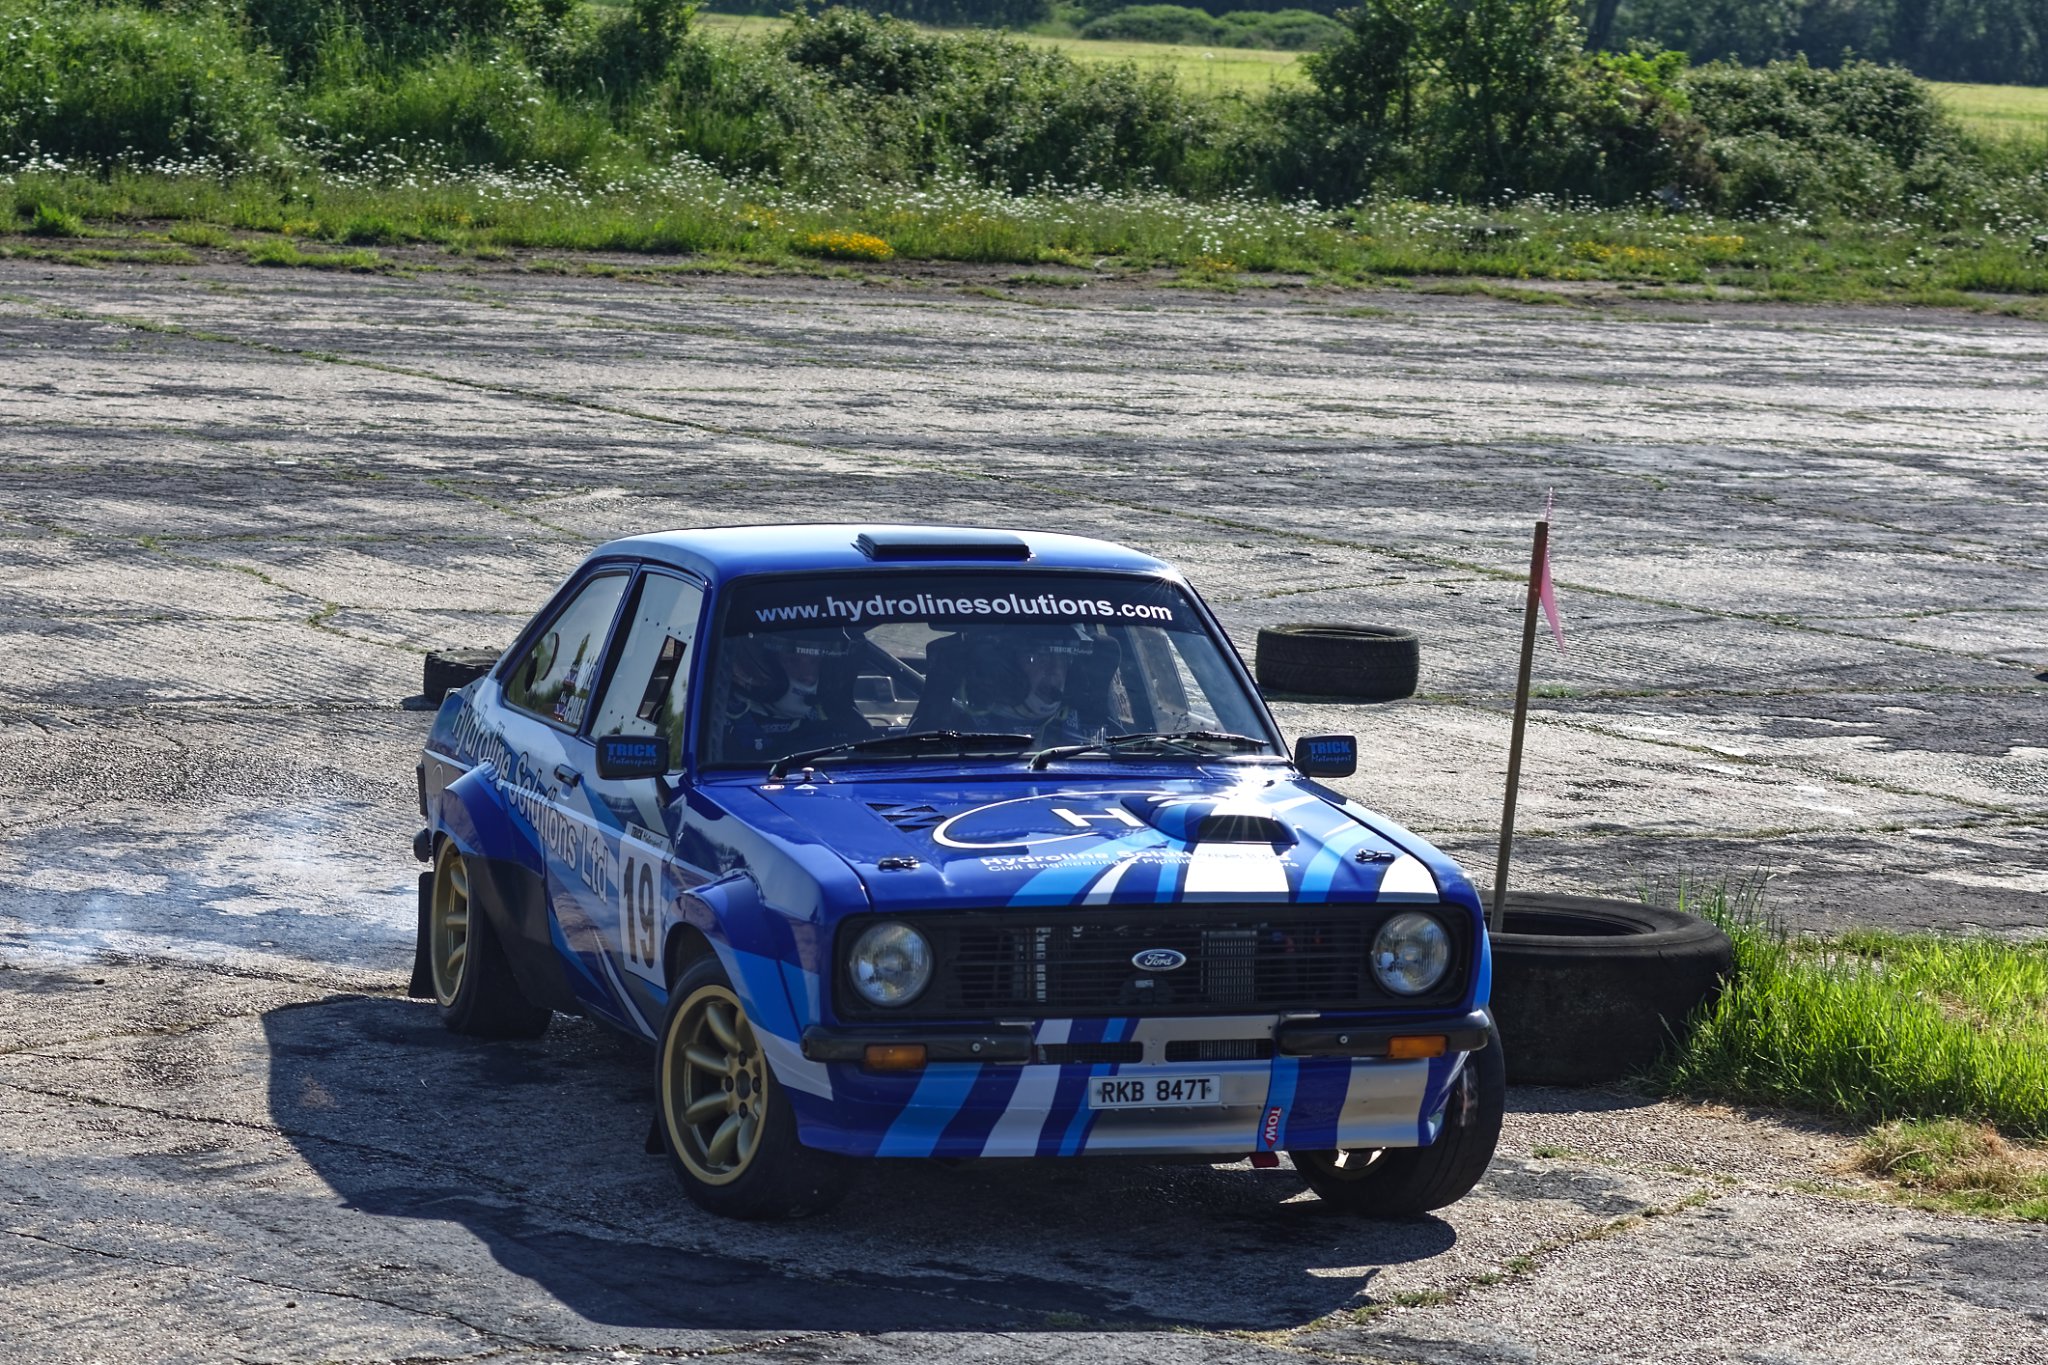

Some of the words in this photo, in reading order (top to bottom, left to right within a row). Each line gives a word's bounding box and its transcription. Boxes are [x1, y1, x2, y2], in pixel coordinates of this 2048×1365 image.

[756, 594, 1173, 622] www.hydrolinesolutions.com
[607, 743, 657, 757] TRICK
[1308, 741, 1351, 754] TRICK
[508, 751, 578, 871] Solutions
[581, 825, 609, 902] Ltd
[980, 853, 1109, 866] Hydroline
[1116, 850, 1203, 859] Soluti
[988, 864, 1023, 872] Civil
[1142, 857, 1194, 865] Pipeli
[624, 856, 655, 969] 19
[1144, 953, 1173, 966] Ford
[1101, 1081, 1145, 1103] RKB
[1156, 1079, 1210, 1101] 847T
[1265, 1107, 1282, 1141] TOW
